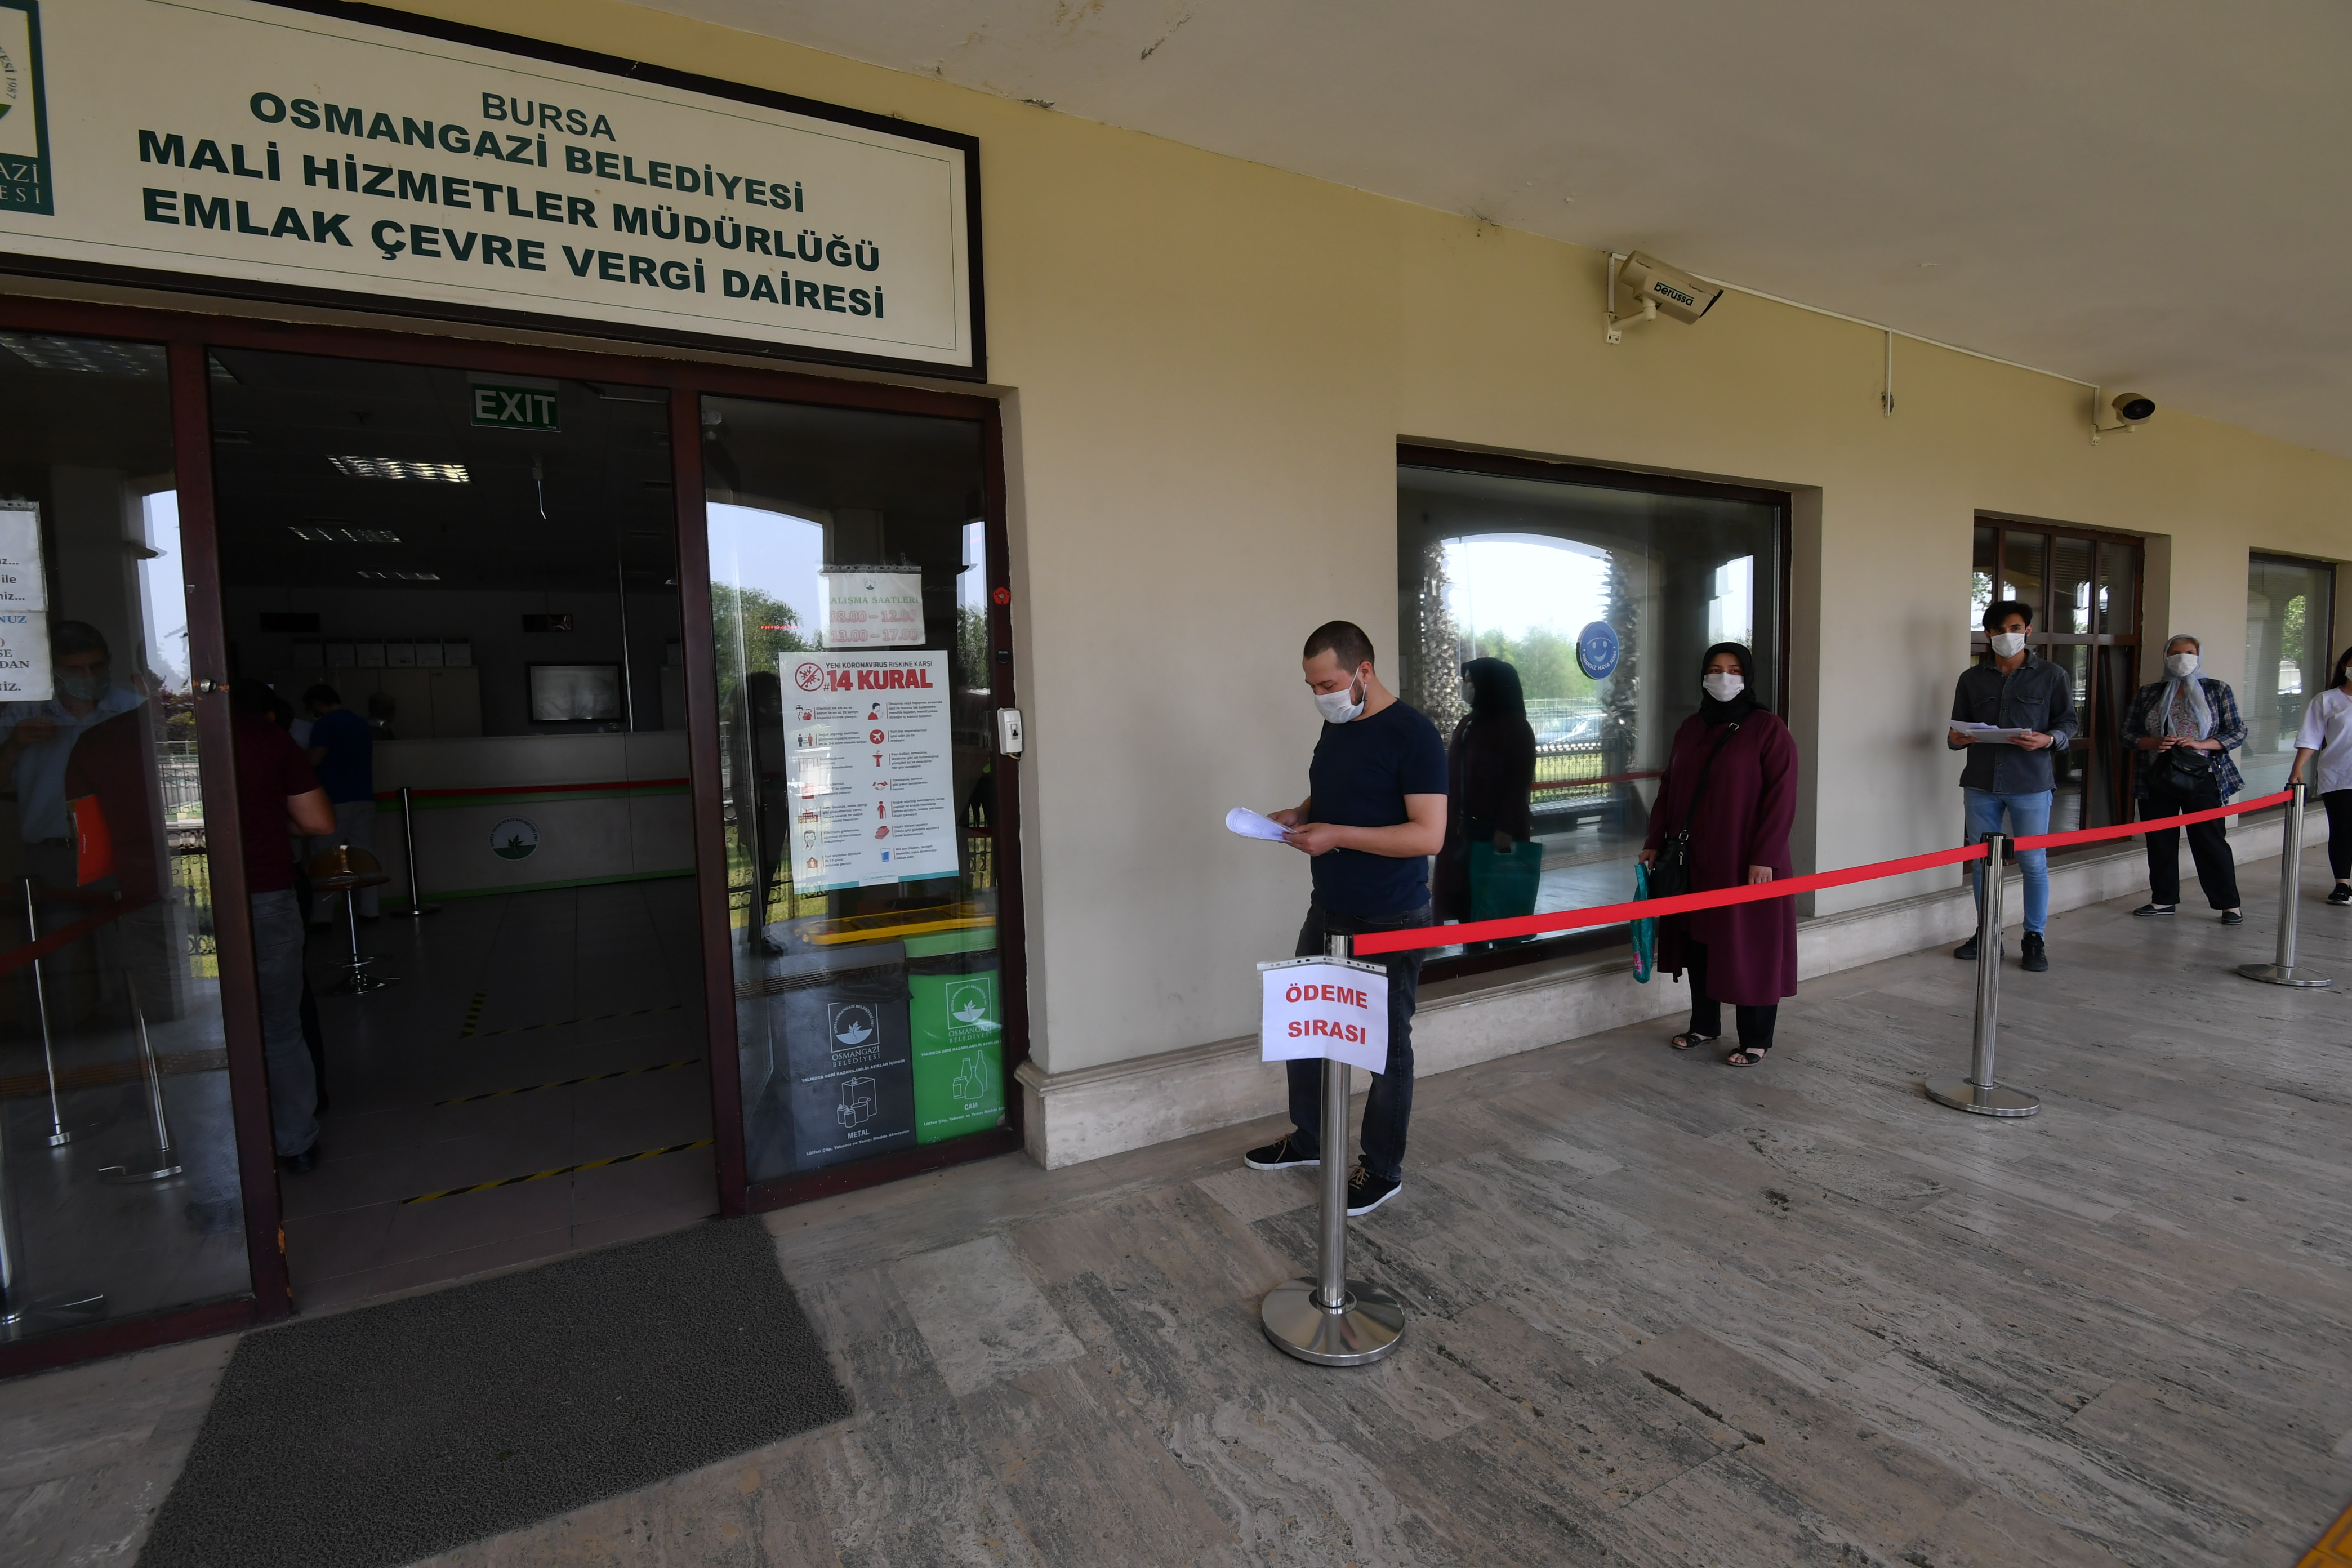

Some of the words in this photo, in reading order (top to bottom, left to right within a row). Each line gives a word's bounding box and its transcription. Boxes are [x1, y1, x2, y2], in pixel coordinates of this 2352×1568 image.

[6, 78, 17, 99] 1987
[482, 92, 616, 142] BURSA
[250, 92, 547, 168] OSMANGAZİ
[565, 145, 804, 213] BELEDİYESİ
[138, 129, 280, 181] MALİ
[302, 153, 598, 228] HİZMETLER
[613, 204, 880, 272] MÜDÜRLÜĞÜ
[142, 186, 354, 247] EMLAK
[371, 220, 546, 272] ÇEVRE
[562, 244, 705, 293] VERGİ
[722, 268, 884, 319] DAİRESİ
[1654, 281, 1695, 306] berussa
[475, 389, 556, 424] EXIT
[1, 574, 17, 583] ile
[826, 596, 868, 606] ALIŞMA
[830, 610, 867, 623] 08.00
[881, 609, 916, 622] 12.00
[831, 629, 868, 643] 13.00
[883, 628, 917, 641] 17.00
[857, 669, 933, 690] KURAL
[1285, 983, 1368, 1009] ÖDEME
[1288, 1019, 1366, 1045] SIRASI
[832, 1045, 880, 1061] OSMANGAZİ
[833, 1053, 880, 1067] BELEDİYESİ
[964, 1102, 978, 1111] CAM
[848, 1129, 870, 1139] METAL
